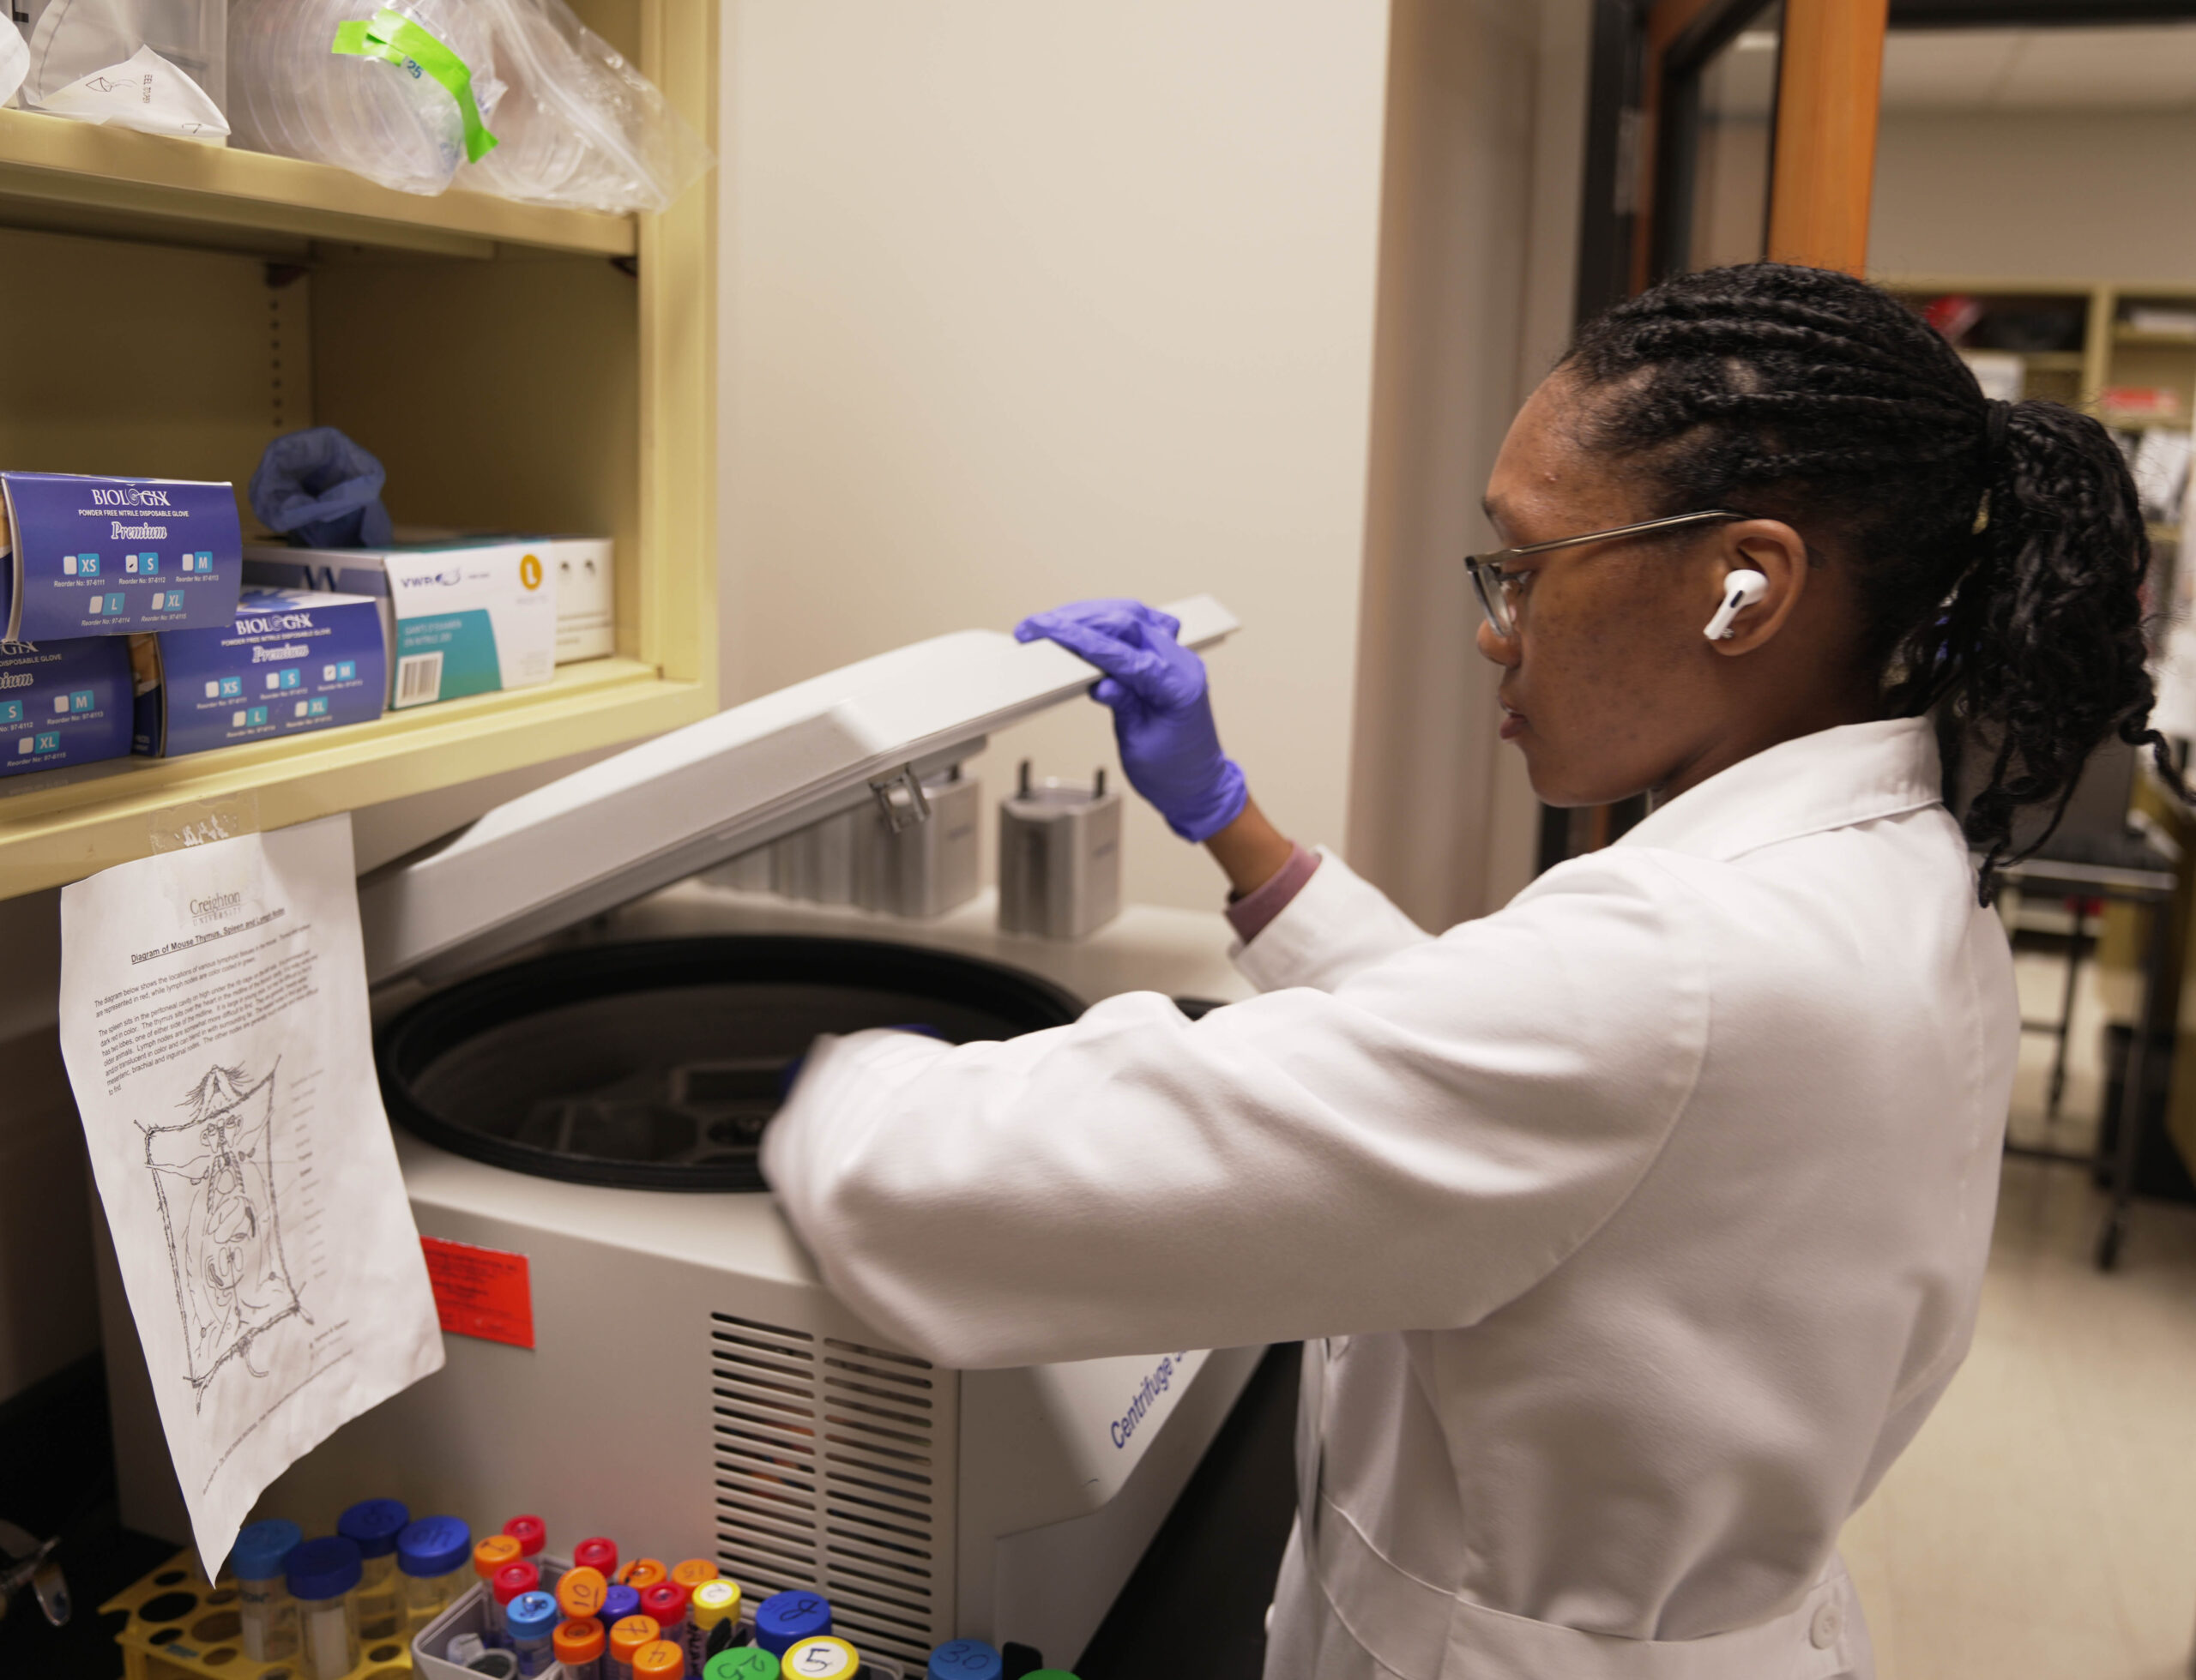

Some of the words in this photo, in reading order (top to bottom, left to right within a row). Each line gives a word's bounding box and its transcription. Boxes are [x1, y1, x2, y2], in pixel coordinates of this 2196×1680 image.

[111, 521, 167, 539] Premium
[81, 559, 96, 573] XS
[148, 557, 154, 570] S
[198, 557, 208, 569] M
[526, 561, 538, 585] L
[111, 598, 118, 611] L
[167, 594, 180, 607] XL
[40, 653, 63, 663] GLOVE
[223, 681, 238, 695] XS
[287, 672, 296, 685] S
[340, 665, 351, 678] M
[9, 706, 17, 719] S
[75, 695, 87, 709] M
[255, 710, 262, 722] L
[312, 701, 325, 714] XL
[39, 736, 56, 750] XL
[189, 891, 241, 916] Creighton
[192, 907, 242, 927] UNIVERSITY
[130, 948, 160, 964] Diagram
[161, 944, 170, 954] of
[171, 939, 194, 951] Mouse
[223, 923, 244, 936] Spleen
[245, 918, 256, 929] and
[104, 991, 123, 1004] diagram
[123, 986, 139, 997] below
[141, 980, 157, 990] shows
[169, 969, 191, 980] locations
[104, 998, 133, 1015] represented
[151, 986, 166, 997] while
[166, 981, 183, 992] lymph
[136, 1039, 156, 1052] Lymph
[1110, 1357, 1173, 1449] Centrifuge
[801, 1647, 833, 1672] 5
[938, 1643, 990, 1671] 30
